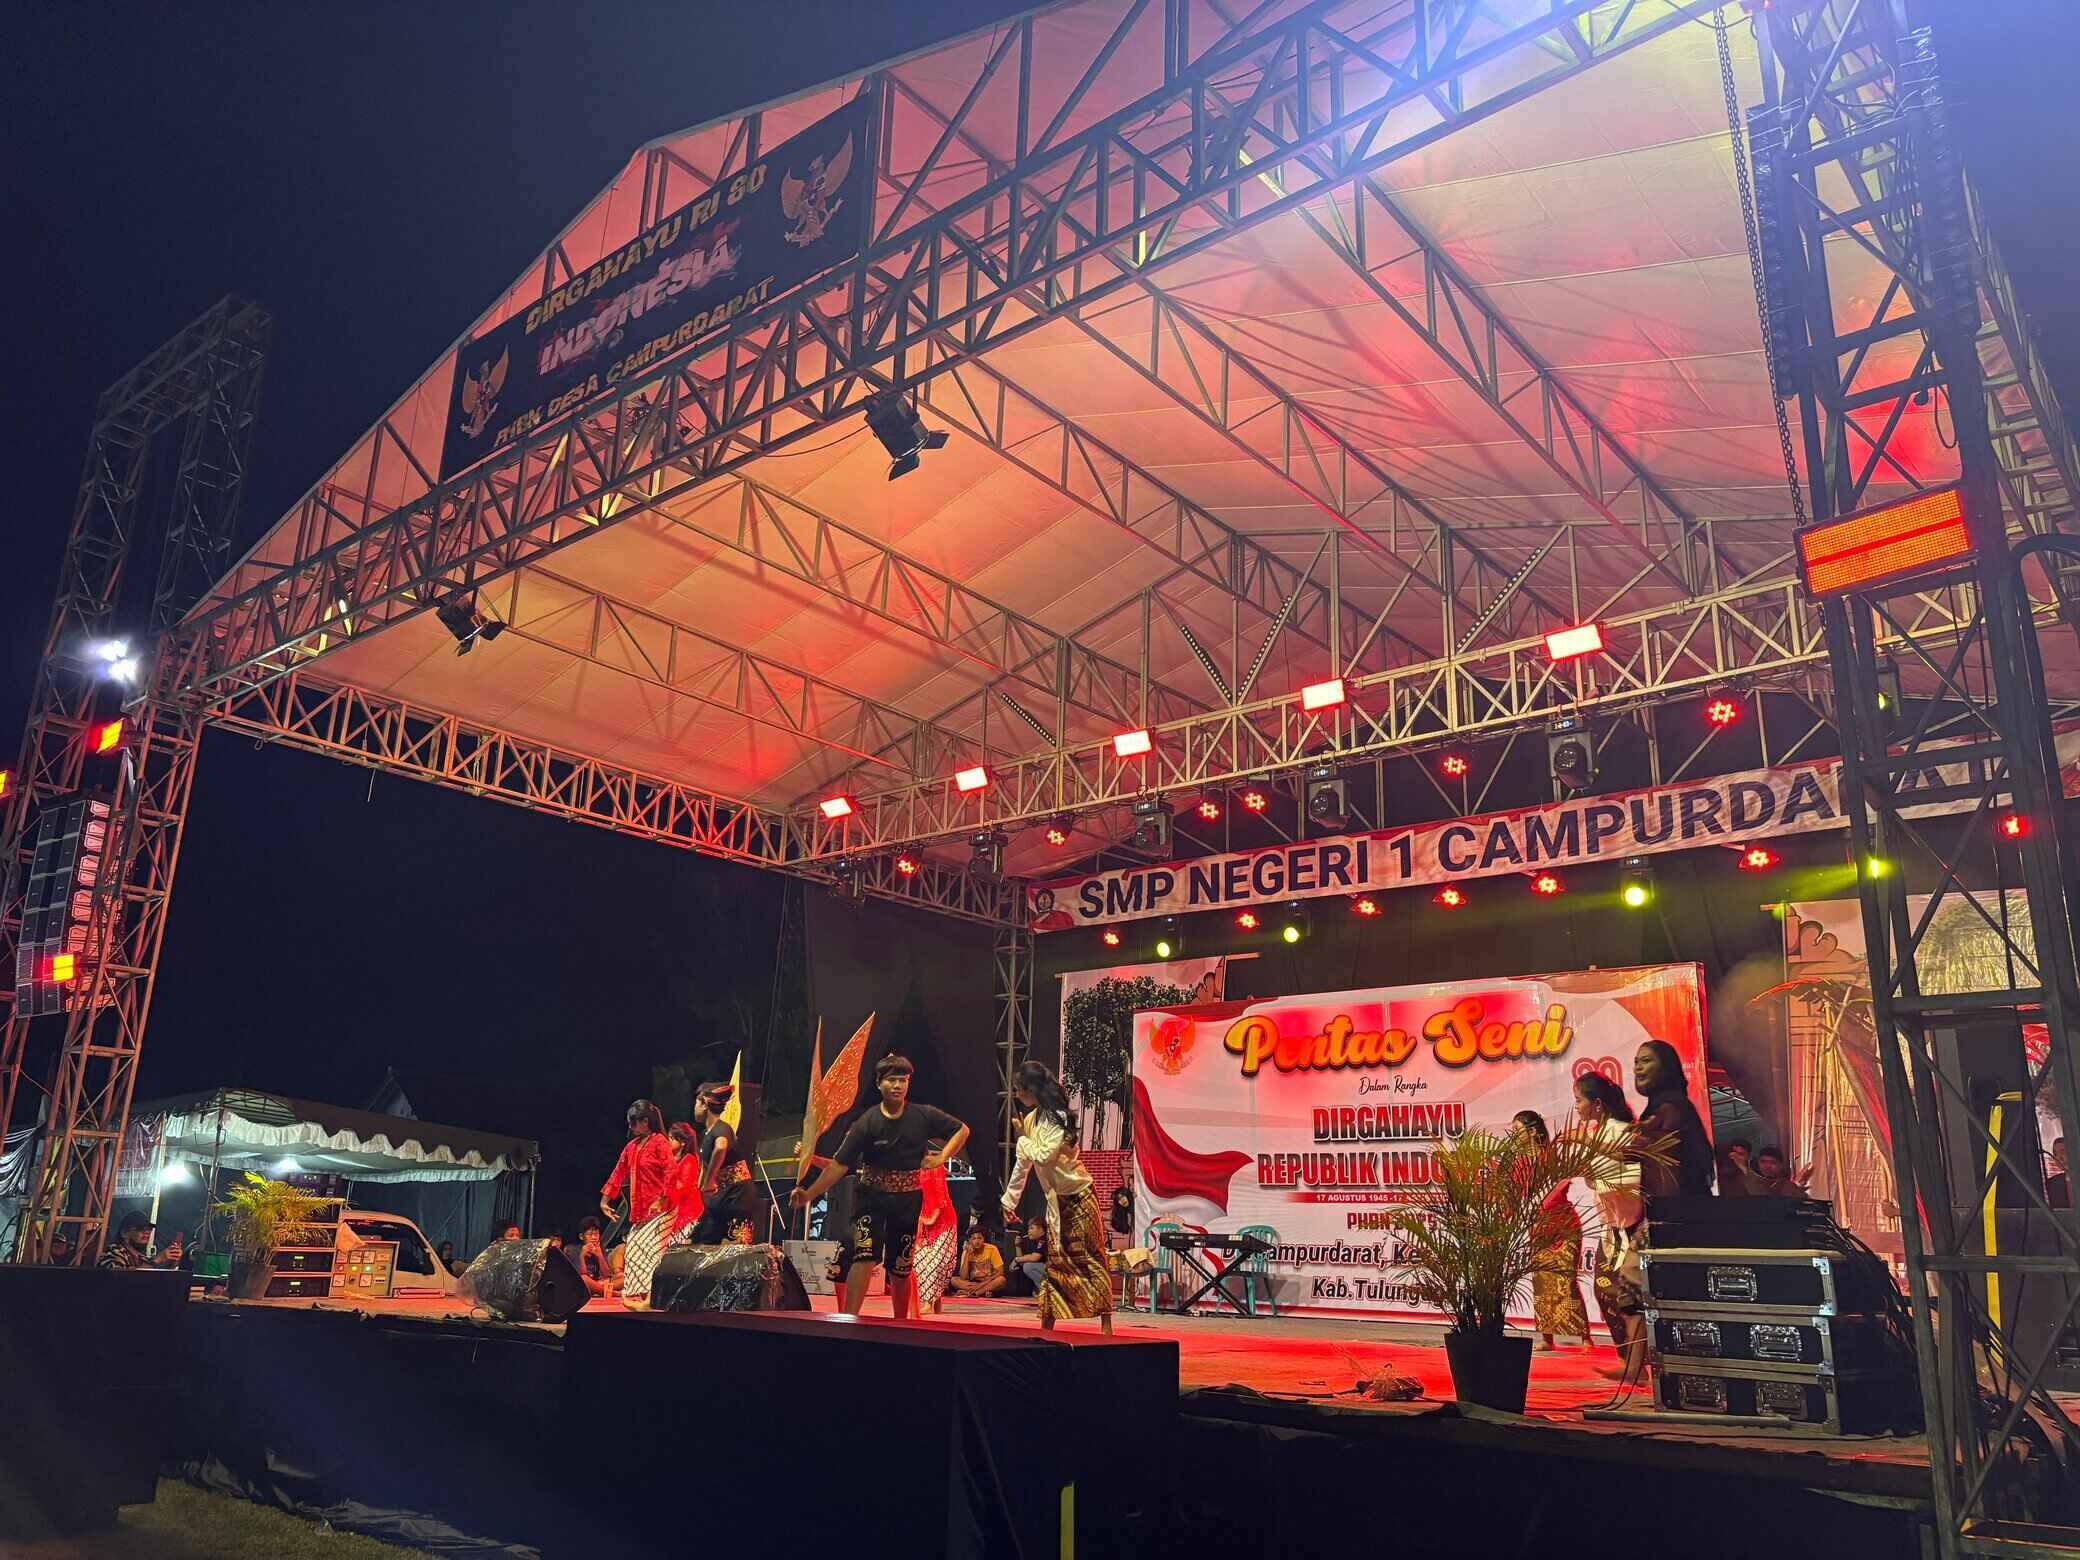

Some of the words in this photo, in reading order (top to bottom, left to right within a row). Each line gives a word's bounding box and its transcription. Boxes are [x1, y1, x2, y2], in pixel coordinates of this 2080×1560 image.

[525, 216, 682, 336] DIRGAHAYU
[689, 191, 721, 231] RI
[727, 164, 768, 206] 80
[537, 234, 737, 377] INDONESIA
[547, 373, 598, 417] DESA
[606, 275, 775, 384] CAMPURDARAT
[1079, 870, 1174, 918] SMP
[1189, 840, 1369, 904] NEGERI
[1390, 839, 1412, 878] 1
[1224, 1014, 1417, 1076] Pantas
[1423, 998, 1574, 1067] Seni
[1359, 1076, 1390, 1095] Dalam
[1394, 1074, 1427, 1096] Rangka
[1313, 1103, 1465, 1141] DIRGAHAYU
[1257, 1152, 1378, 1186] REPUBLIK
[1316, 1193, 1325, 1202] 17
[1327, 1193, 1366, 1202] AGUSTUS
[1368, 1193, 1388, 1202] 1945
[1347, 1212, 1390, 1231] PHBN
[1262, 1240, 1384, 1269] ampurdarat,
